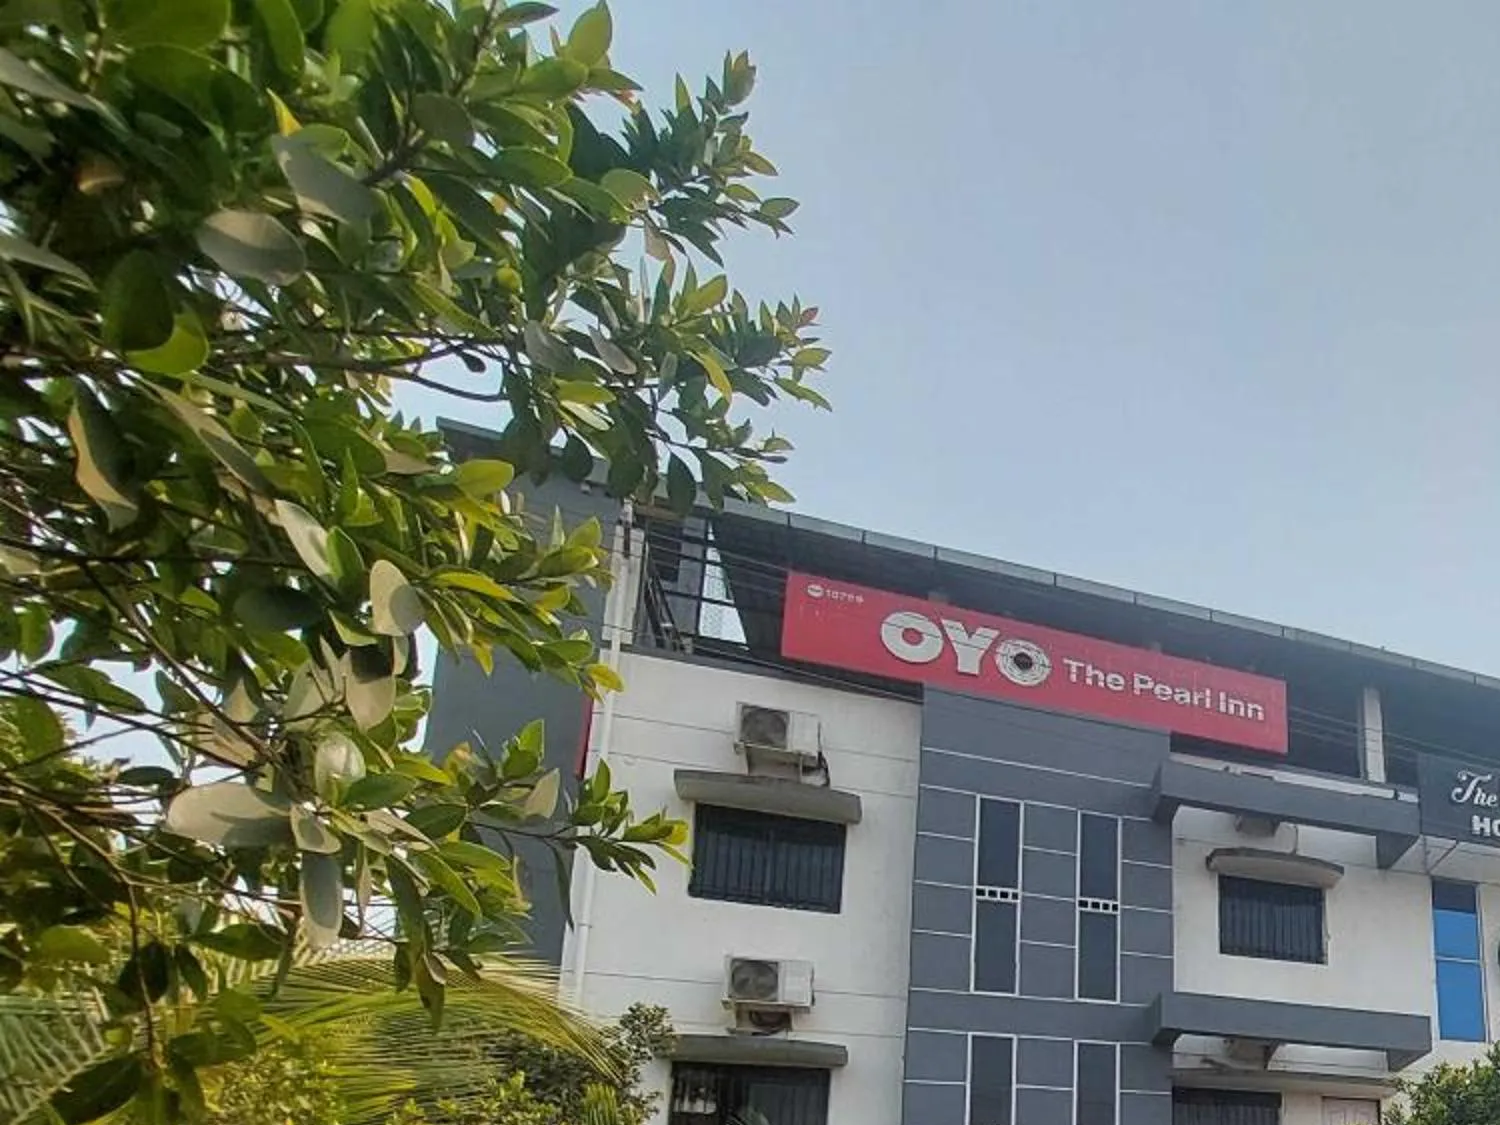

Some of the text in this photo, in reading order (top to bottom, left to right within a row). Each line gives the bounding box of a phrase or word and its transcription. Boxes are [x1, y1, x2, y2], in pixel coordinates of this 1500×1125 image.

[880, 611, 1053, 687] OYO
[1063, 658, 1265, 721] The Pearl Inn
[1451, 769, 1498, 808] The
